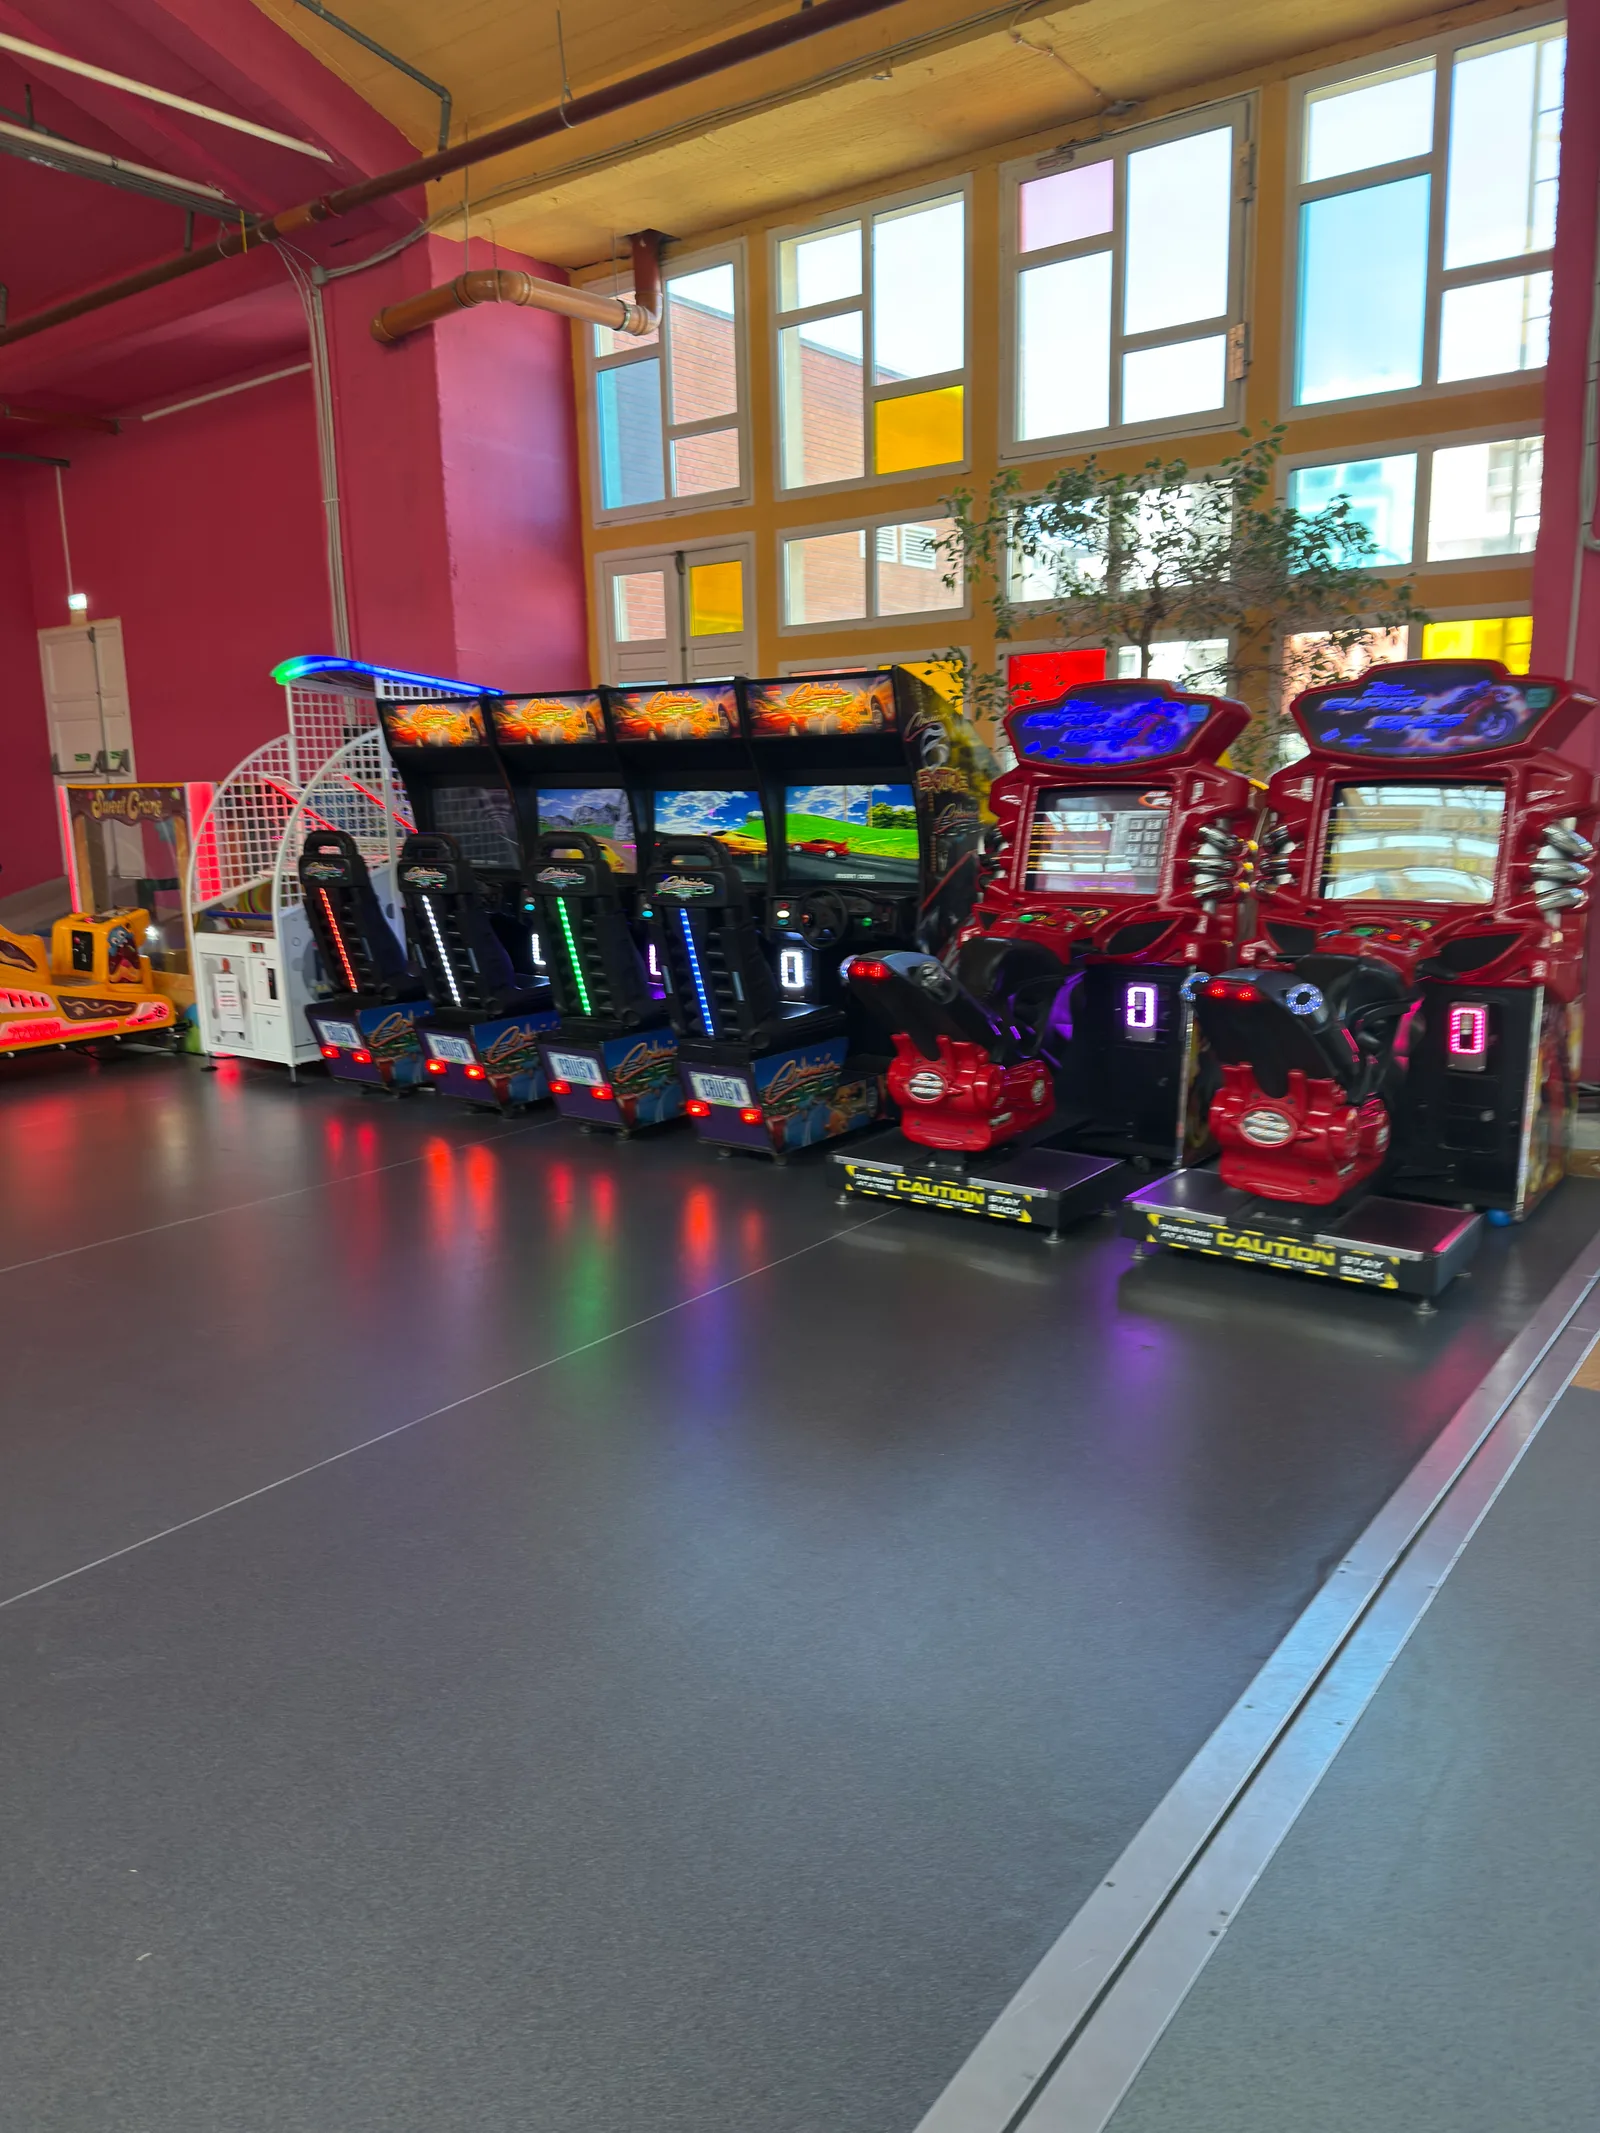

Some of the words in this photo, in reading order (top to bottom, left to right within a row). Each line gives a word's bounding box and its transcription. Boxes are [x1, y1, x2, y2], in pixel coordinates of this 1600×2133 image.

[557, 1058, 597, 1080] CRUIS'N
[701, 1078, 745, 1101] CRUIS'N
[897, 1178, 984, 1205] CAUTION
[988, 1194, 1021, 1208] STAY
[988, 1203, 1021, 1216] BACK
[1216, 1231, 1336, 1266] CAUTION
[1341, 1254, 1385, 1271] STAY
[1340, 1265, 1384, 1282] BACK
